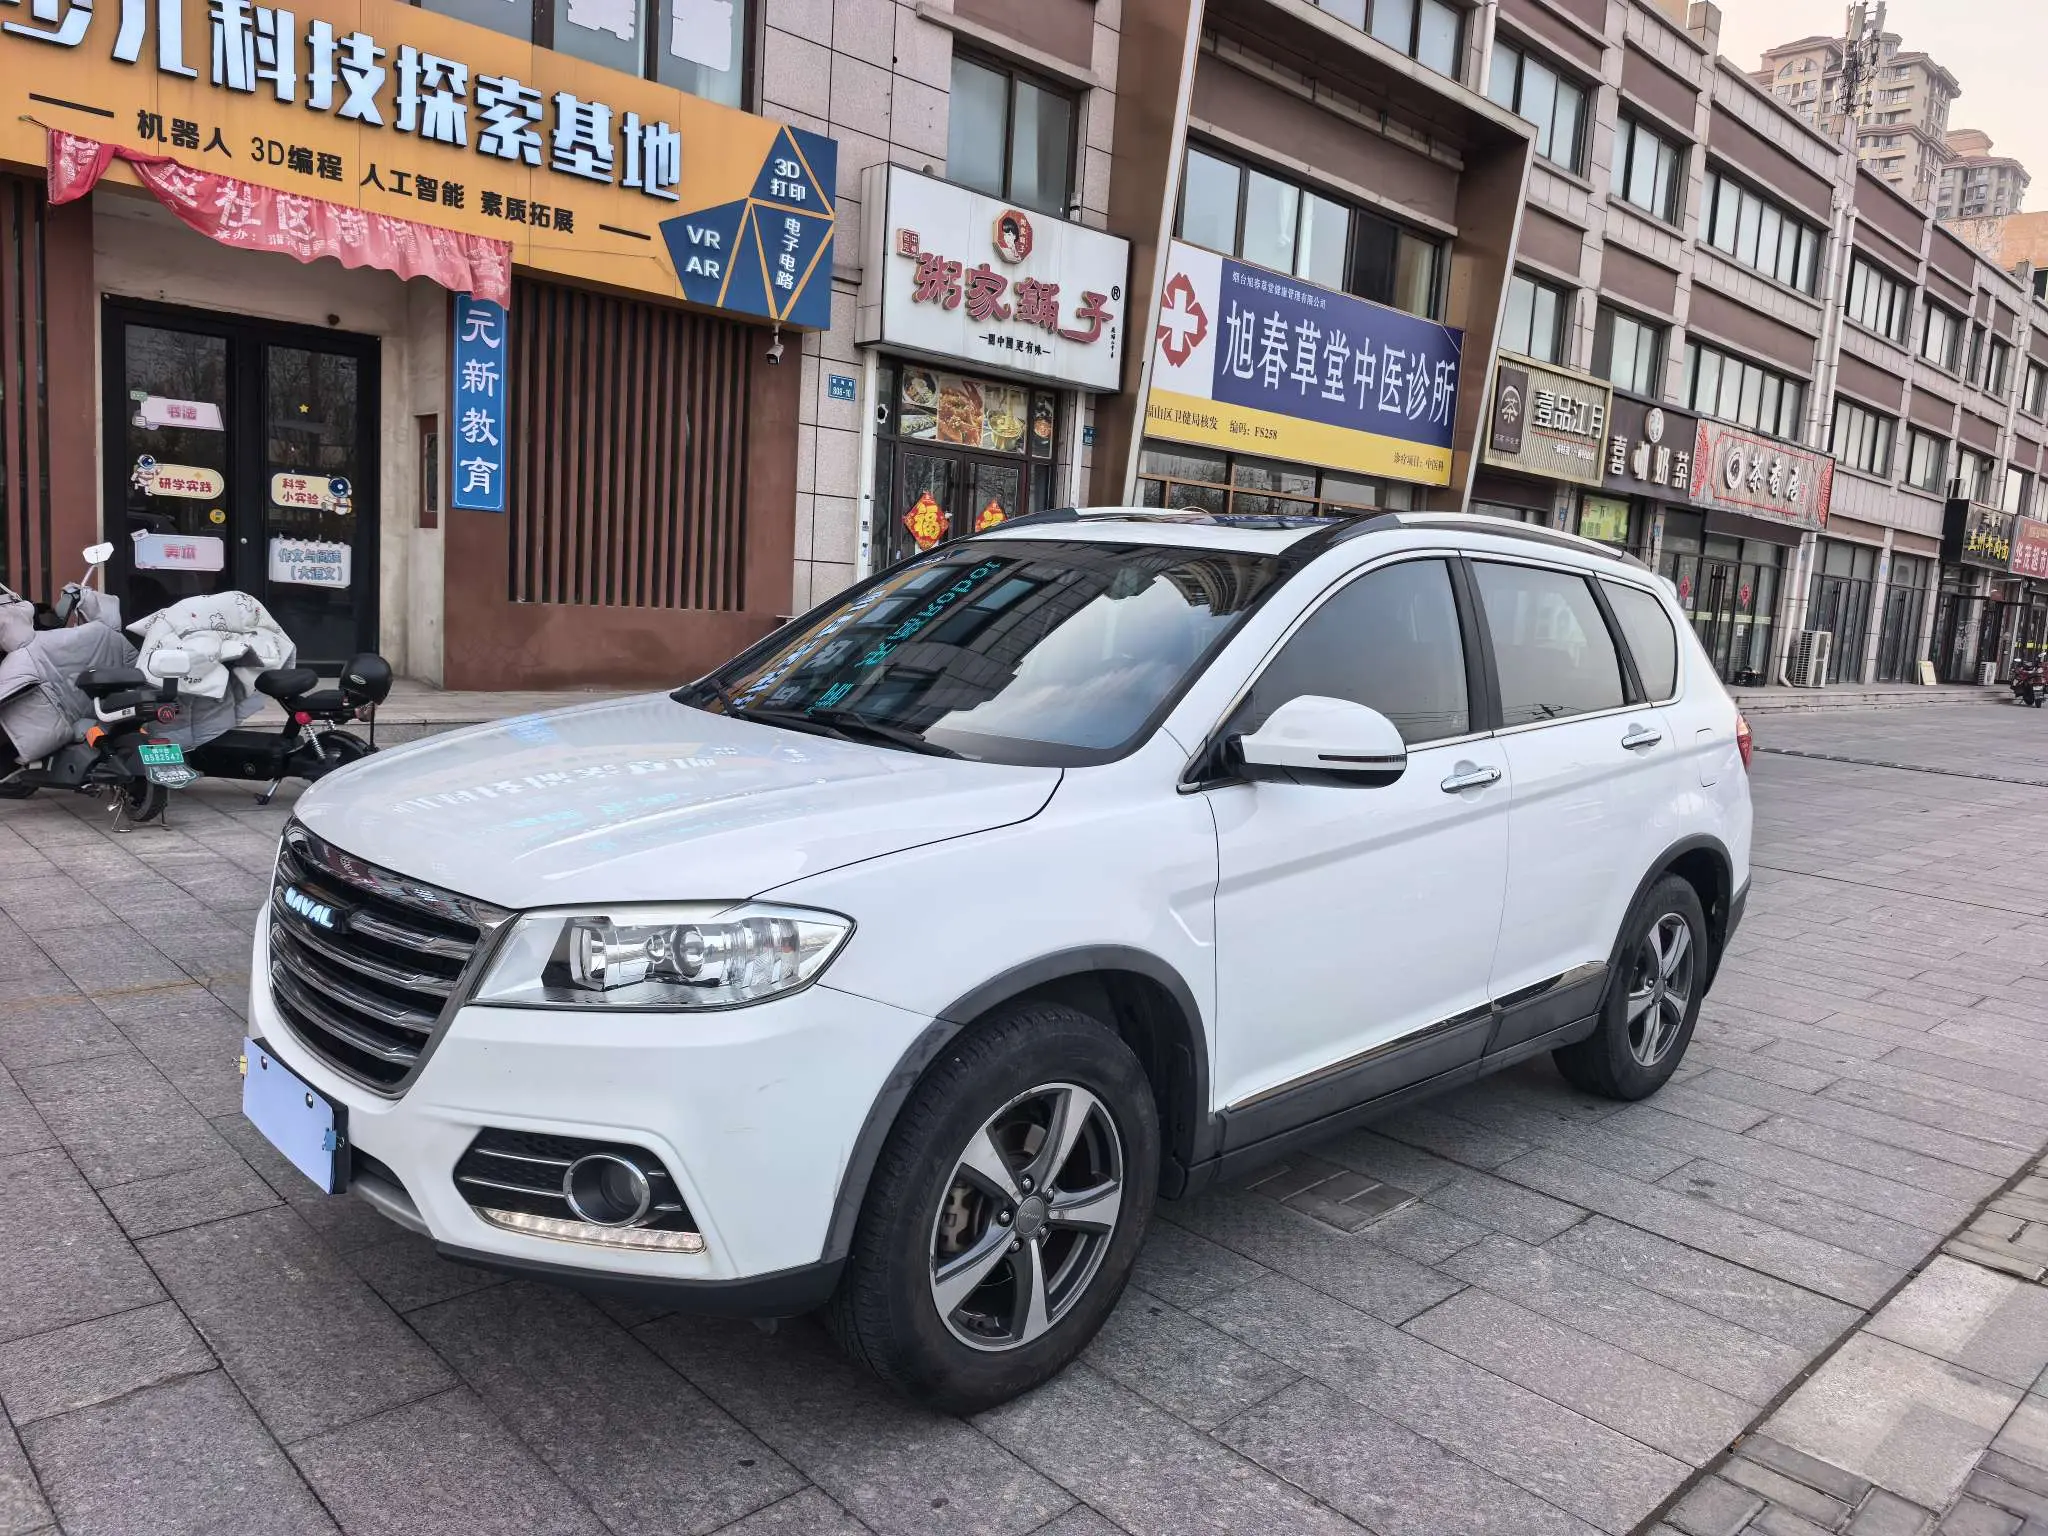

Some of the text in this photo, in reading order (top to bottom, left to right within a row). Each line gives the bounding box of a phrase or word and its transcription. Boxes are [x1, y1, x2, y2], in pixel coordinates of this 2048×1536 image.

[137, 109, 574, 233] 机器人 3D编程 人工智能 素质拓展
[774, 158, 800, 179] 3D
[770, 178, 806, 202] 打印
[686, 225, 721, 250] VR
[775, 217, 801, 290] 电子电路
[685, 255, 720, 280] AR
[1222, 299, 1456, 427] 旭春草堂中医诊所
[460, 309, 502, 495] 元新教育
[1532, 389, 1604, 439] 壹品江月
[914, 503, 941, 539] 福
[285, 886, 334, 928] HAVAL
